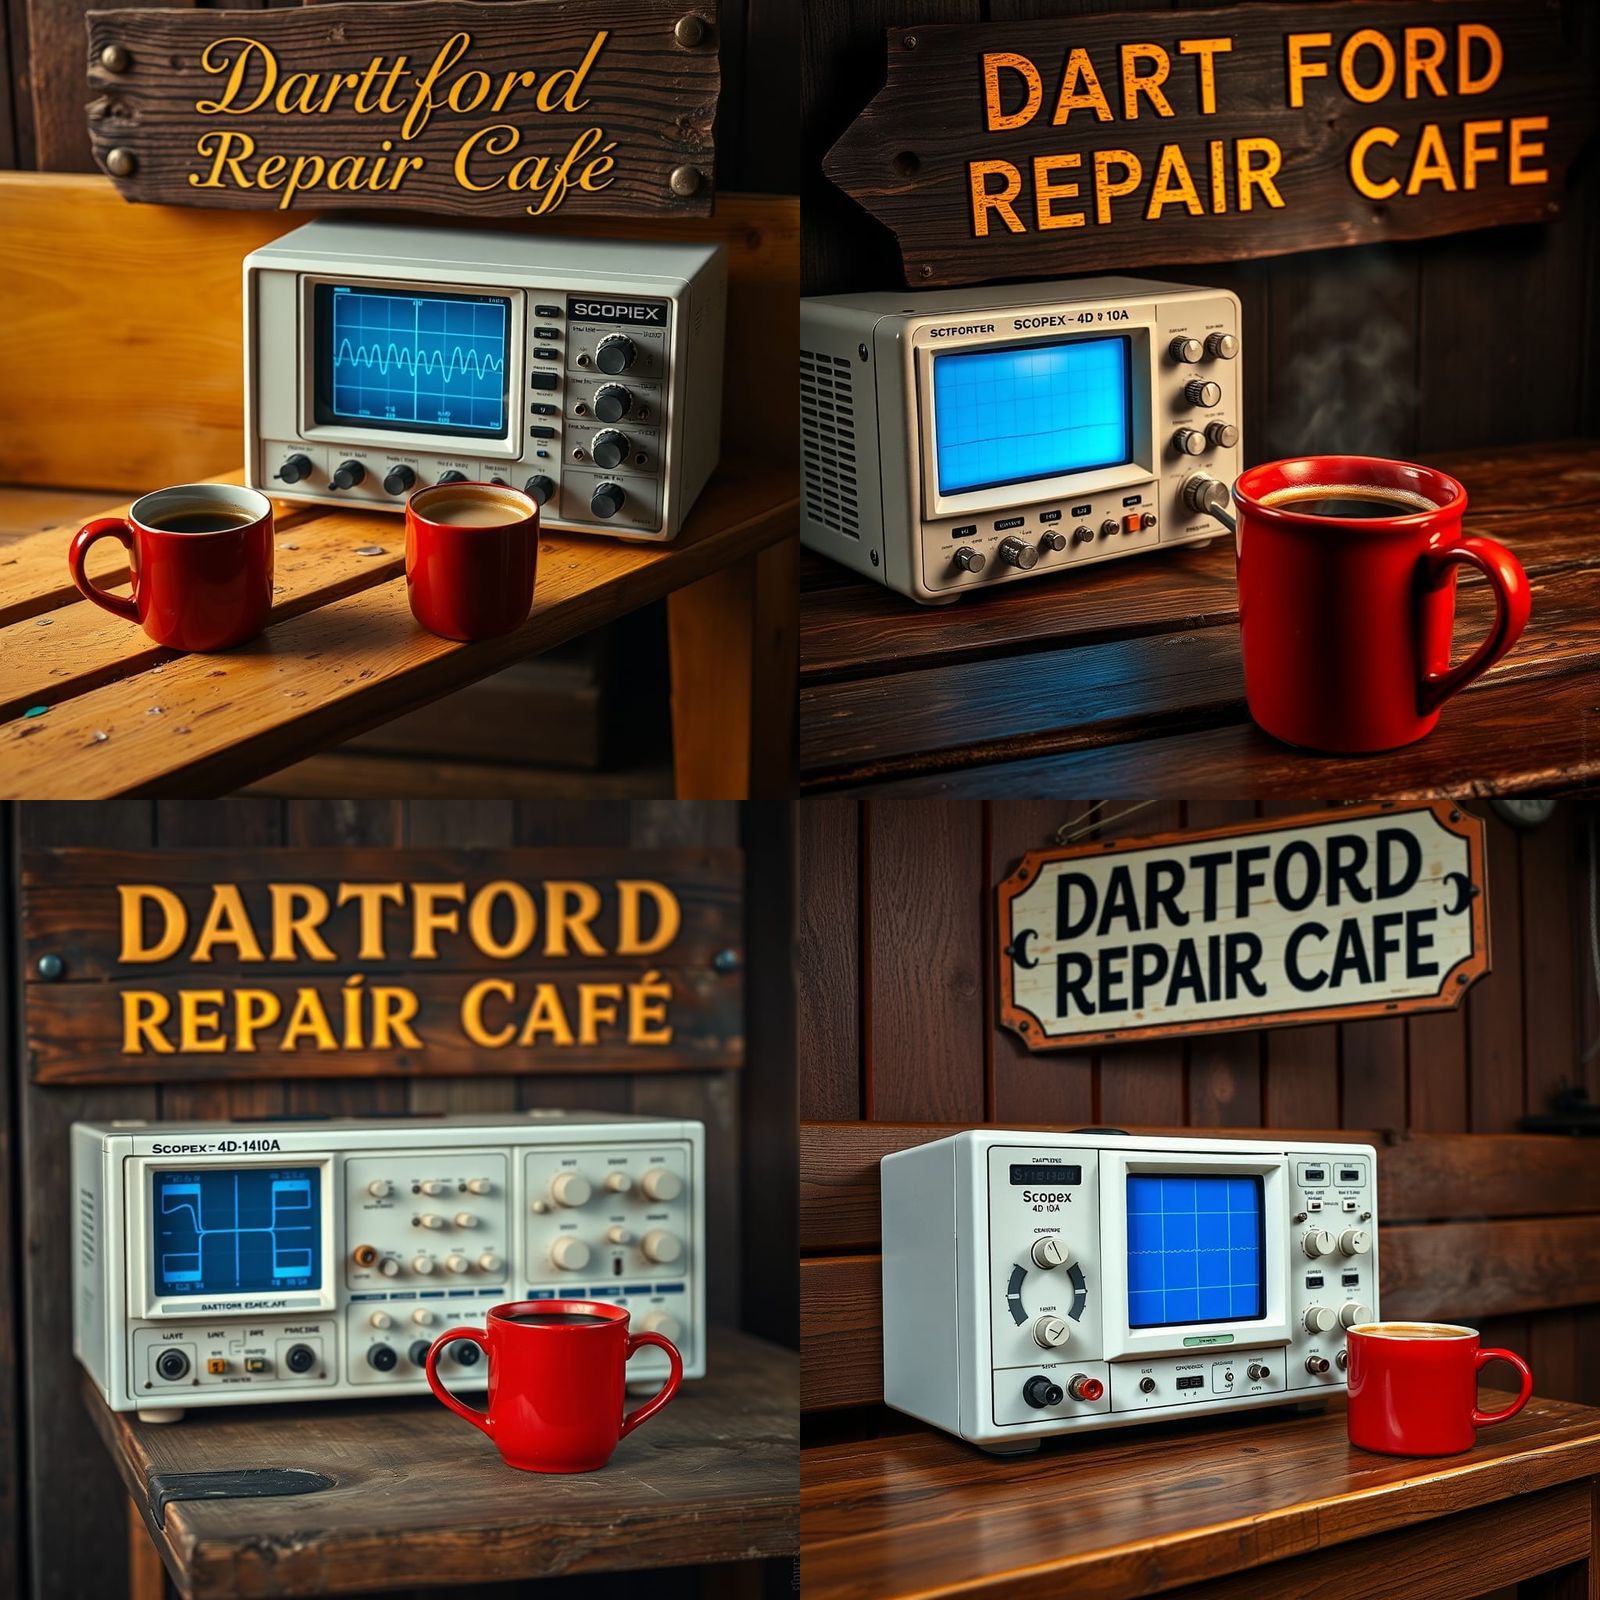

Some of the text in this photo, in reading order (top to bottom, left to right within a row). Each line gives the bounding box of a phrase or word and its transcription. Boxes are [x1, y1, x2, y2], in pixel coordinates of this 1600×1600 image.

[195, 31, 609, 141] Darttford
[980, 23, 1504, 132] DART FORD
[188, 124, 619, 216] Repair Café
[968, 115, 1549, 238] REPAIR CAFE
[574, 303, 659, 320] SCOPIEX
[117, 880, 681, 962] DARTFORD
[1056, 828, 1423, 942] DARTFORD
[461, 970, 673, 1048] CAFÉ
[1056, 907, 1440, 1018] REPAIR CAFE
[1023, 1190, 1072, 1203] Scopex
